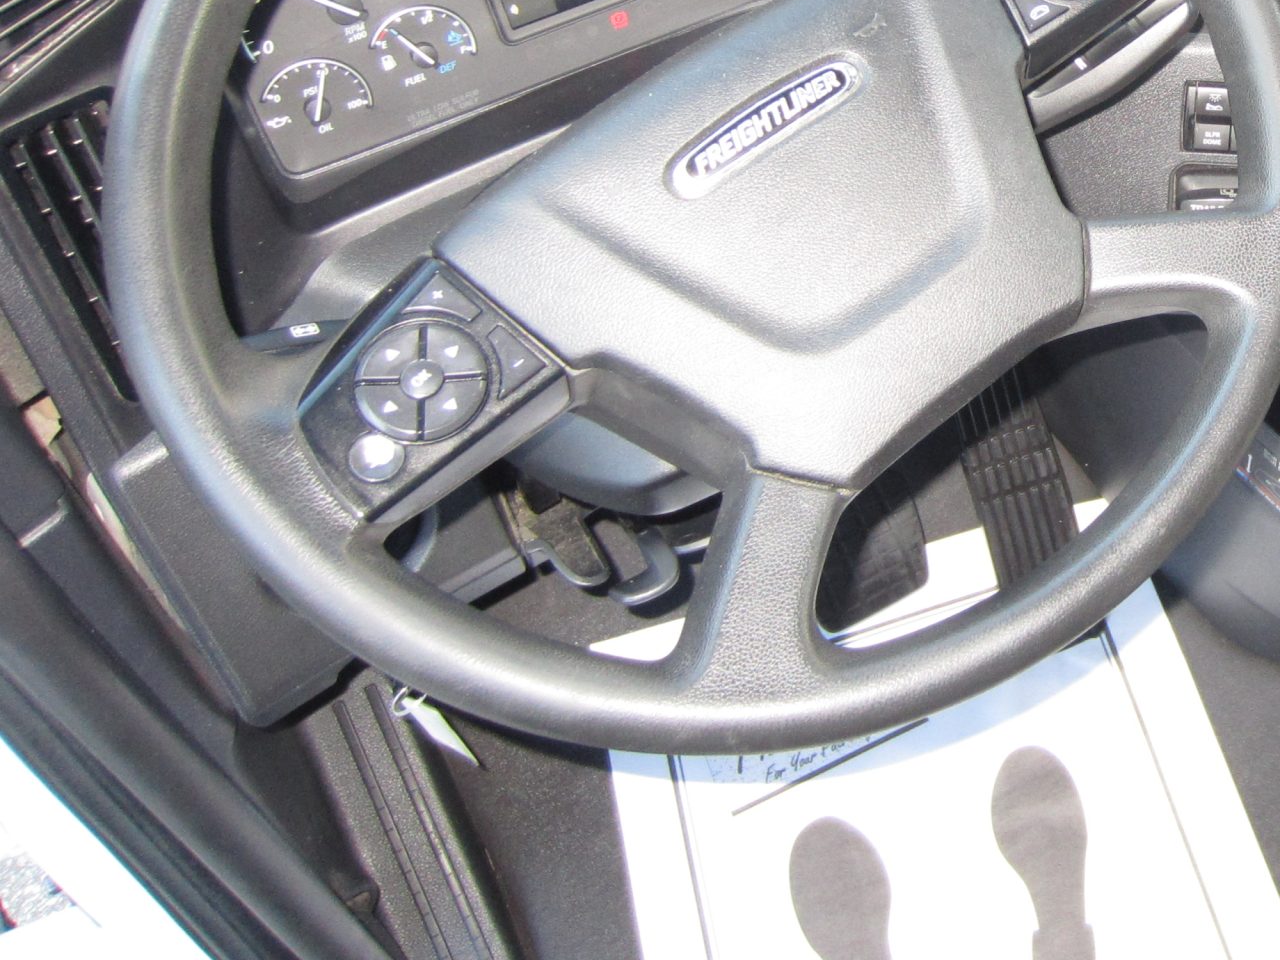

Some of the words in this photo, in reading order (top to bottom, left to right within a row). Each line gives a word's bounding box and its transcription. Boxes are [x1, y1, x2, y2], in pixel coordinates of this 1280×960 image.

[344, 23, 365, 36] RPM
[263, 41, 274, 54] 0
[439, 61, 456, 73] DEF
[405, 73, 427, 87] FUEL
[303, 85, 318, 97] PSI
[347, 98, 362, 109] 100
[318, 123, 333, 134] OIL
[693, 70, 841, 176] FREIGHTLINER
